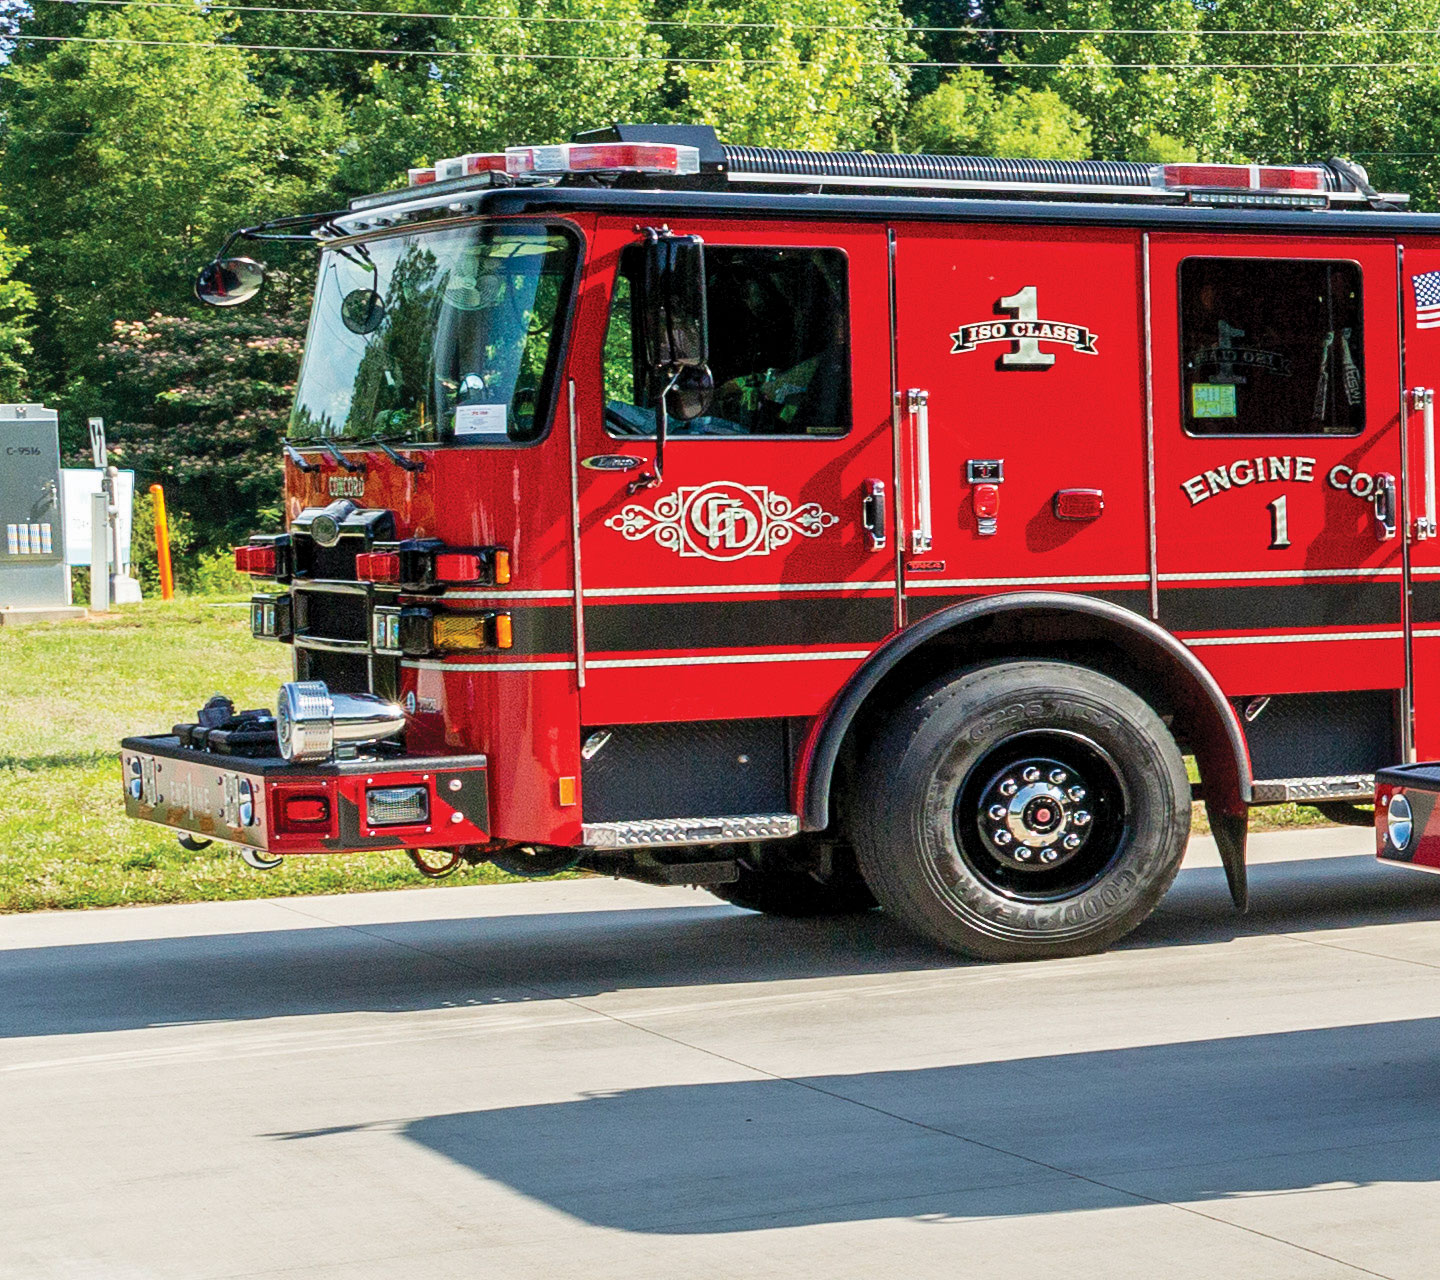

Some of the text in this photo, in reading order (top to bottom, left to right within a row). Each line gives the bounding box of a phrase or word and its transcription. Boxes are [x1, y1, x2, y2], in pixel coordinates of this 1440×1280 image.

[968, 322, 1080, 342] ISO CLASS
[1001, 286, 1056, 365] 1
[1181, 456, 1374, 504] ENGINE CO.
[1271, 494, 1291, 546] 1
